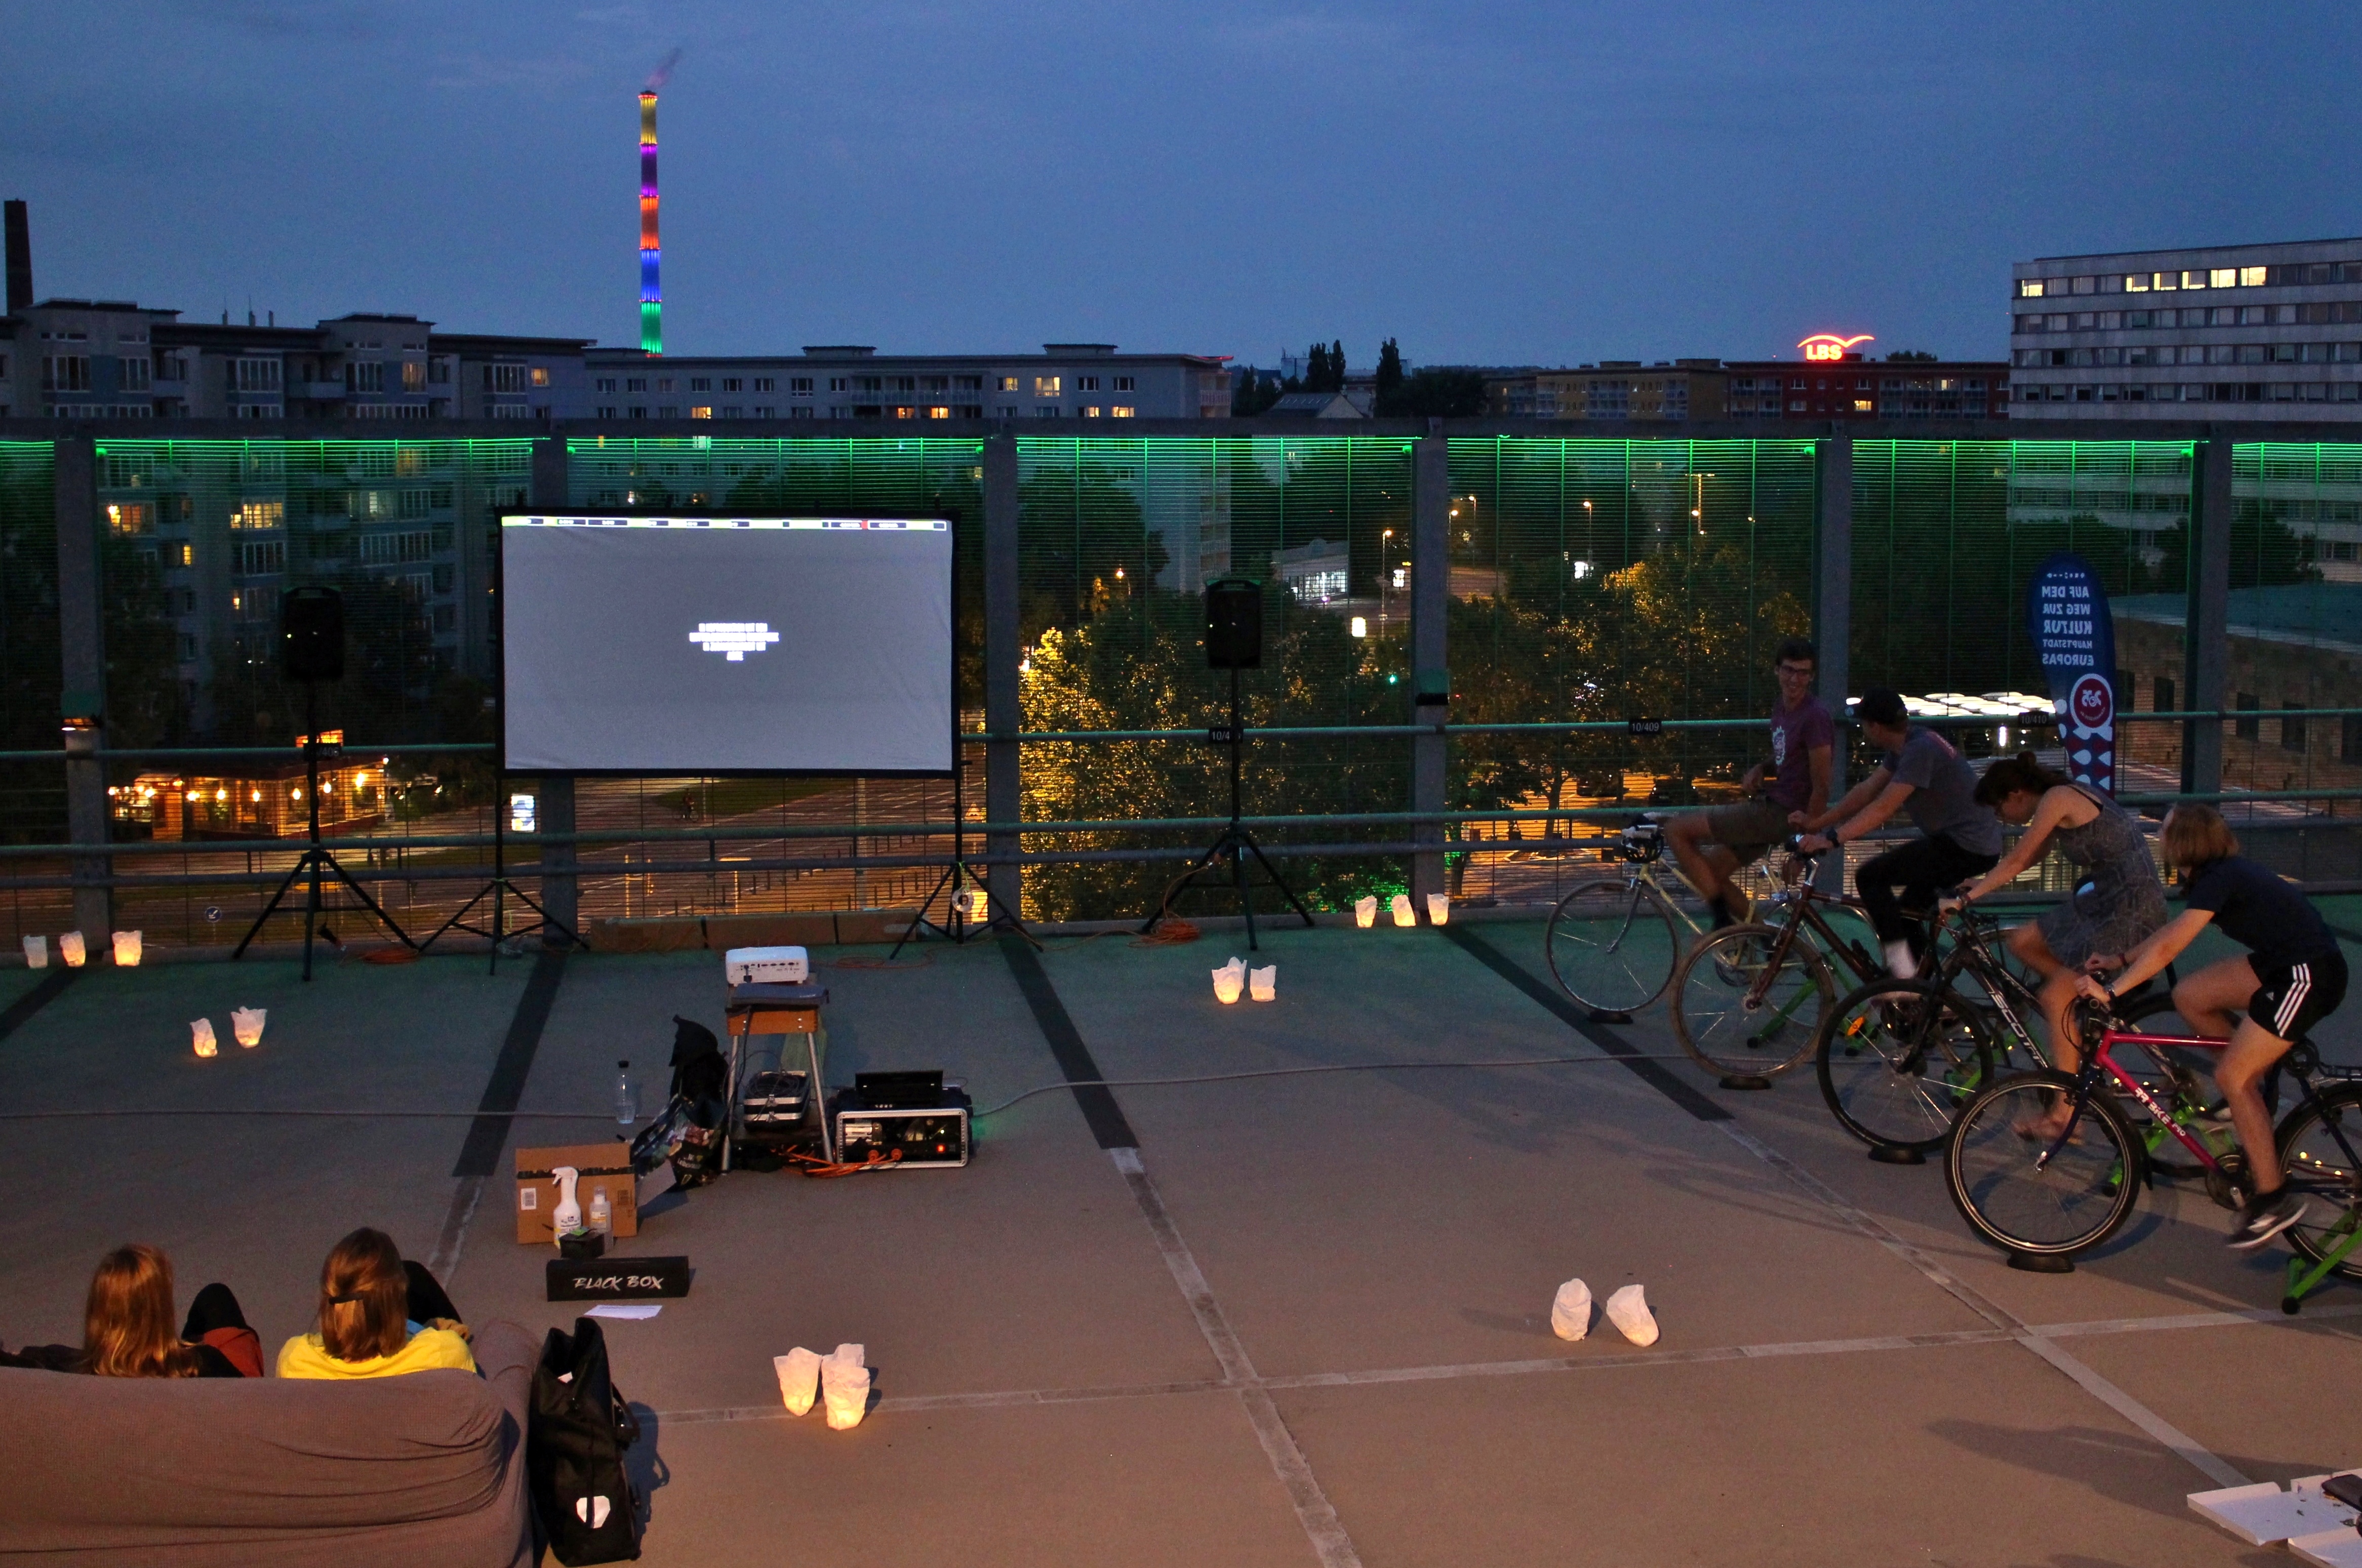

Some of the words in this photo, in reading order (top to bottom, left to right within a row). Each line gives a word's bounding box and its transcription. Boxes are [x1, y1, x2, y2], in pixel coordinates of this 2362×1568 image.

[1806, 344, 1842, 360] LBS
[2022, 714, 2047, 724] 10/410
[1631, 722, 1659, 732] 10/409
[1212, 731, 1241, 741] 10/4
[573, 1275, 623, 1291] BLACK
[627, 1275, 664, 1290] BOX
